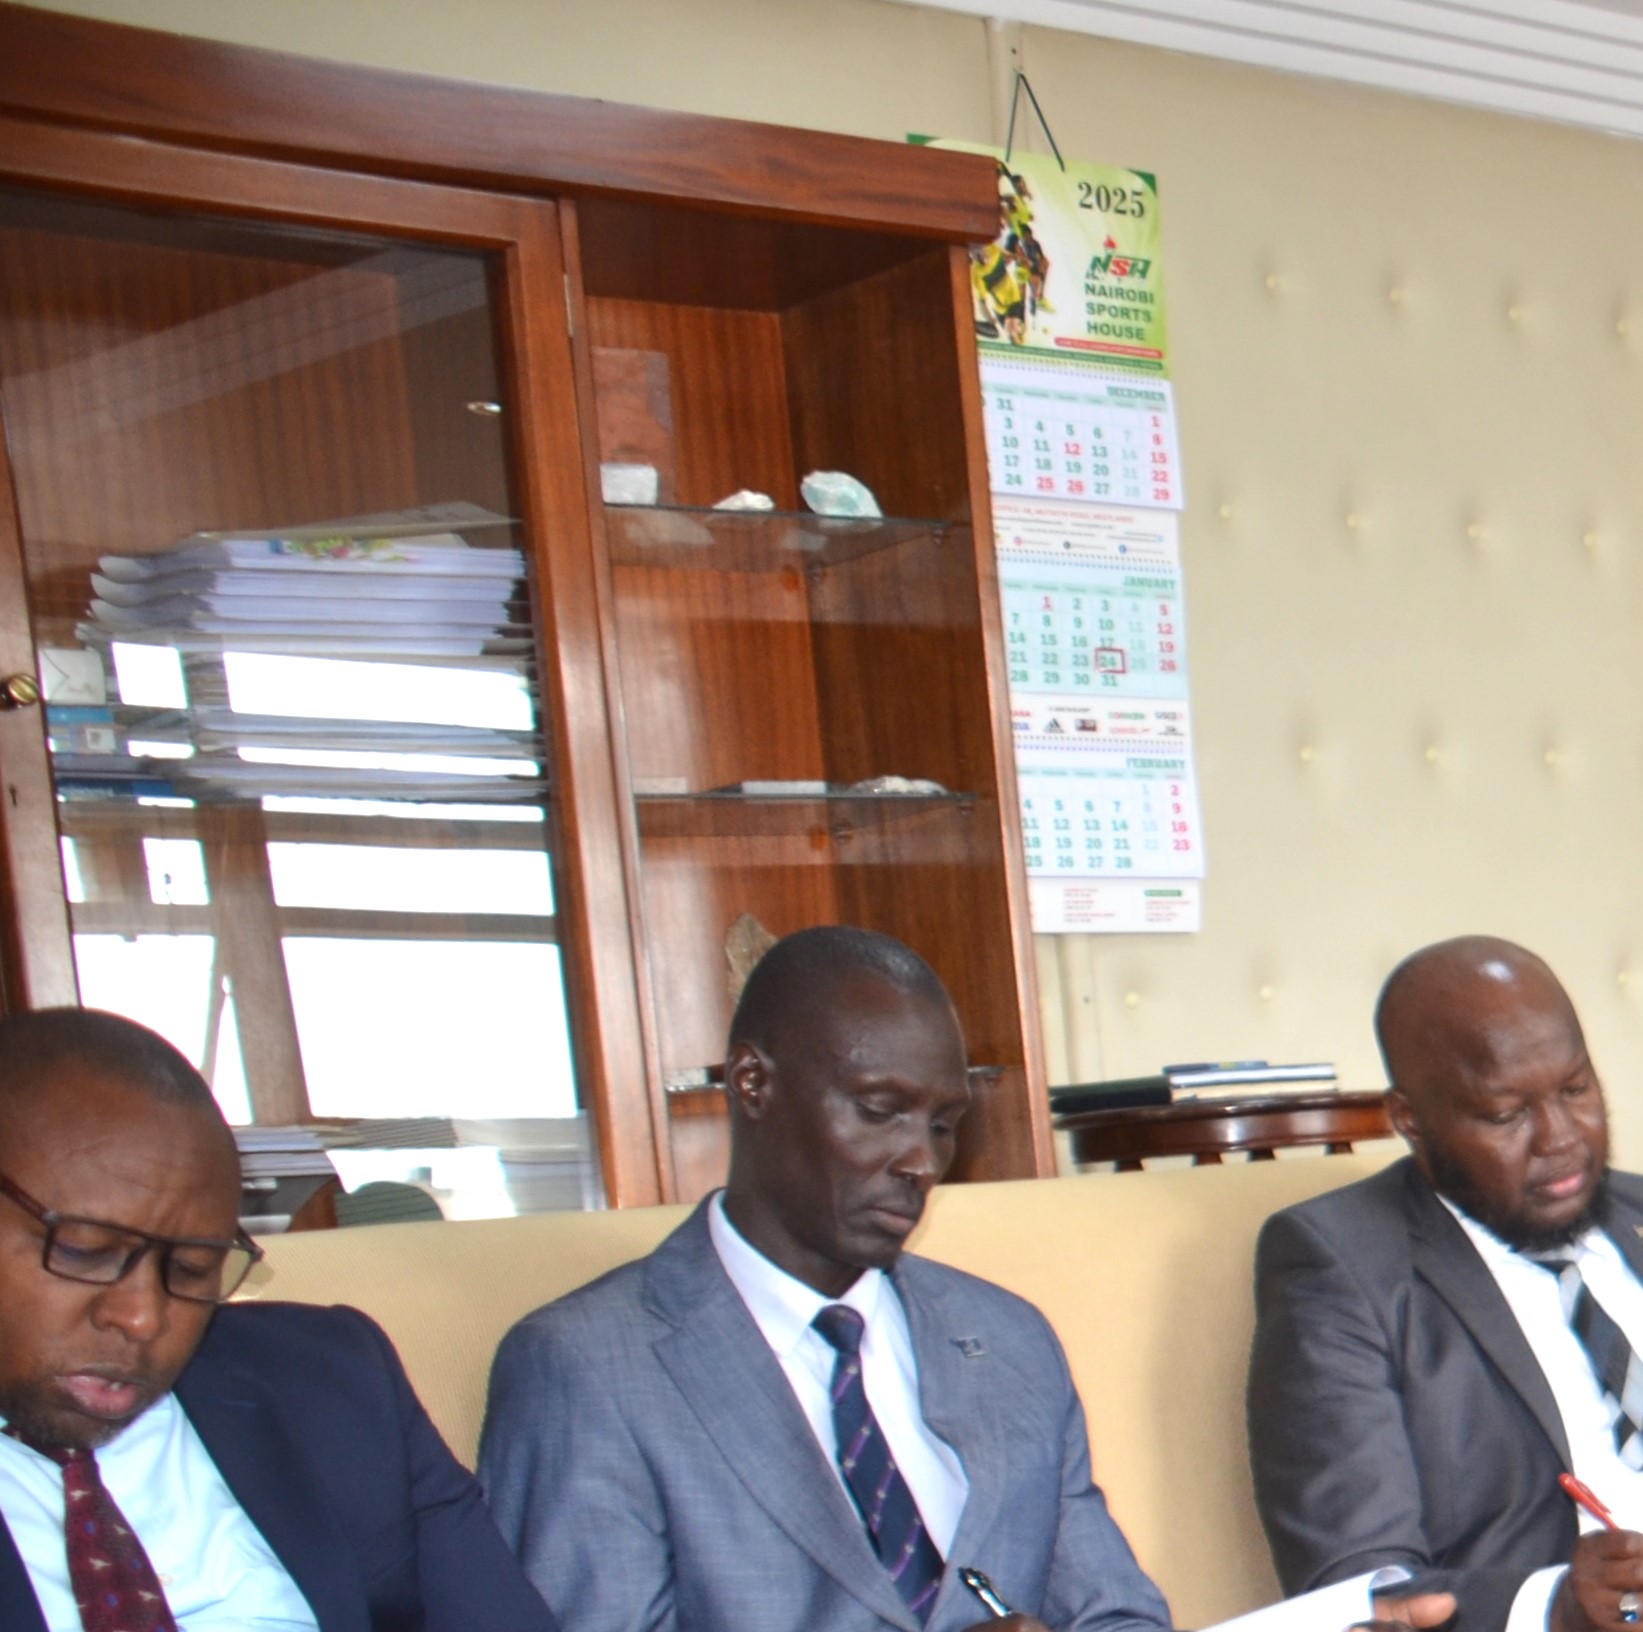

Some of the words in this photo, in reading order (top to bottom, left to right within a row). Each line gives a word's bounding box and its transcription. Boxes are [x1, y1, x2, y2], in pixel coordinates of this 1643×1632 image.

[1078, 182, 1145, 218] 2025
[1085, 283, 1154, 304] NAIROBI
[1086, 302, 1152, 323] SPORTS
[1087, 322, 1145, 340] HOUSE
[1107, 386, 1166, 401] DECEMBER
[997, 398, 1013, 411] 31
[1152, 416, 1160, 427] 1
[1005, 418, 1012, 429] 3
[1035, 421, 1043, 432] 4
[1066, 424, 1074, 436] 5
[1094, 428, 1102, 438] 6
[1003, 437, 1018, 448] 10
[1034, 440, 1050, 452] 11
[1065, 443, 1080, 455] 12
[1092, 446, 1108, 458] 13
[1151, 452, 1167, 464] 15
[1005, 455, 1019, 467] 17
[1035, 459, 1052, 470] 18
[1066, 462, 1082, 473] 19
[1093, 465, 1109, 476] 20
[1152, 471, 1168, 482] 22
[1006, 474, 1022, 485] 24
[1037, 477, 1053, 489] 25
[1067, 480, 1084, 493] 26
[1095, 483, 1109, 494] 27
[1153, 489, 1169, 500] 29
[1123, 576, 1176, 589] JANUARY
[1043, 596, 1052, 611] 1
[1073, 599, 1081, 610] 2
[1102, 600, 1109, 611] 3
[1159, 604, 1168, 615] 5
[1011, 613, 1019, 624] 7
[1043, 615, 1051, 626] 8
[1074, 617, 1082, 628] 9
[1099, 619, 1114, 630] 10
[1158, 623, 1173, 634] 12
[1009, 632, 1026, 643] 14
[1041, 634, 1057, 645] 15
[1072, 636, 1088, 647] 16
[1159, 642, 1174, 653] 19
[1010, 652, 1027, 663] 21
[1042, 653, 1058, 665] 22
[1073, 655, 1089, 667] 23
[1100, 657, 1116, 667] 24
[1159, 660, 1176, 672] 26
[1011, 671, 1028, 682] 28
[1044, 672, 1060, 683] 29
[1074, 674, 1090, 685] 30
[1102, 675, 1118, 687] 31
[1126, 758, 1186, 769] FEBRUARY
[1171, 785, 1179, 796] 2
[1024, 800, 1032, 810] 4
[1055, 801, 1063, 811] 5
[1085, 801, 1094, 812] 6
[1114, 802, 1121, 812] 7
[1173, 803, 1181, 814] 9
[1054, 819, 1070, 830] 12
[1084, 820, 1100, 831] 13
[1112, 821, 1128, 831] 14
[1172, 822, 1188, 833] 16
[1056, 838, 1072, 849] 19
[1086, 839, 1102, 849] 20
[1114, 839, 1130, 850] 21
[1174, 840, 1190, 851] 23
[1026, 856, 1042, 867] 25
[1058, 857, 1074, 867] 26
[1088, 857, 1103, 868] 27
[1115, 858, 1132, 869] 28
